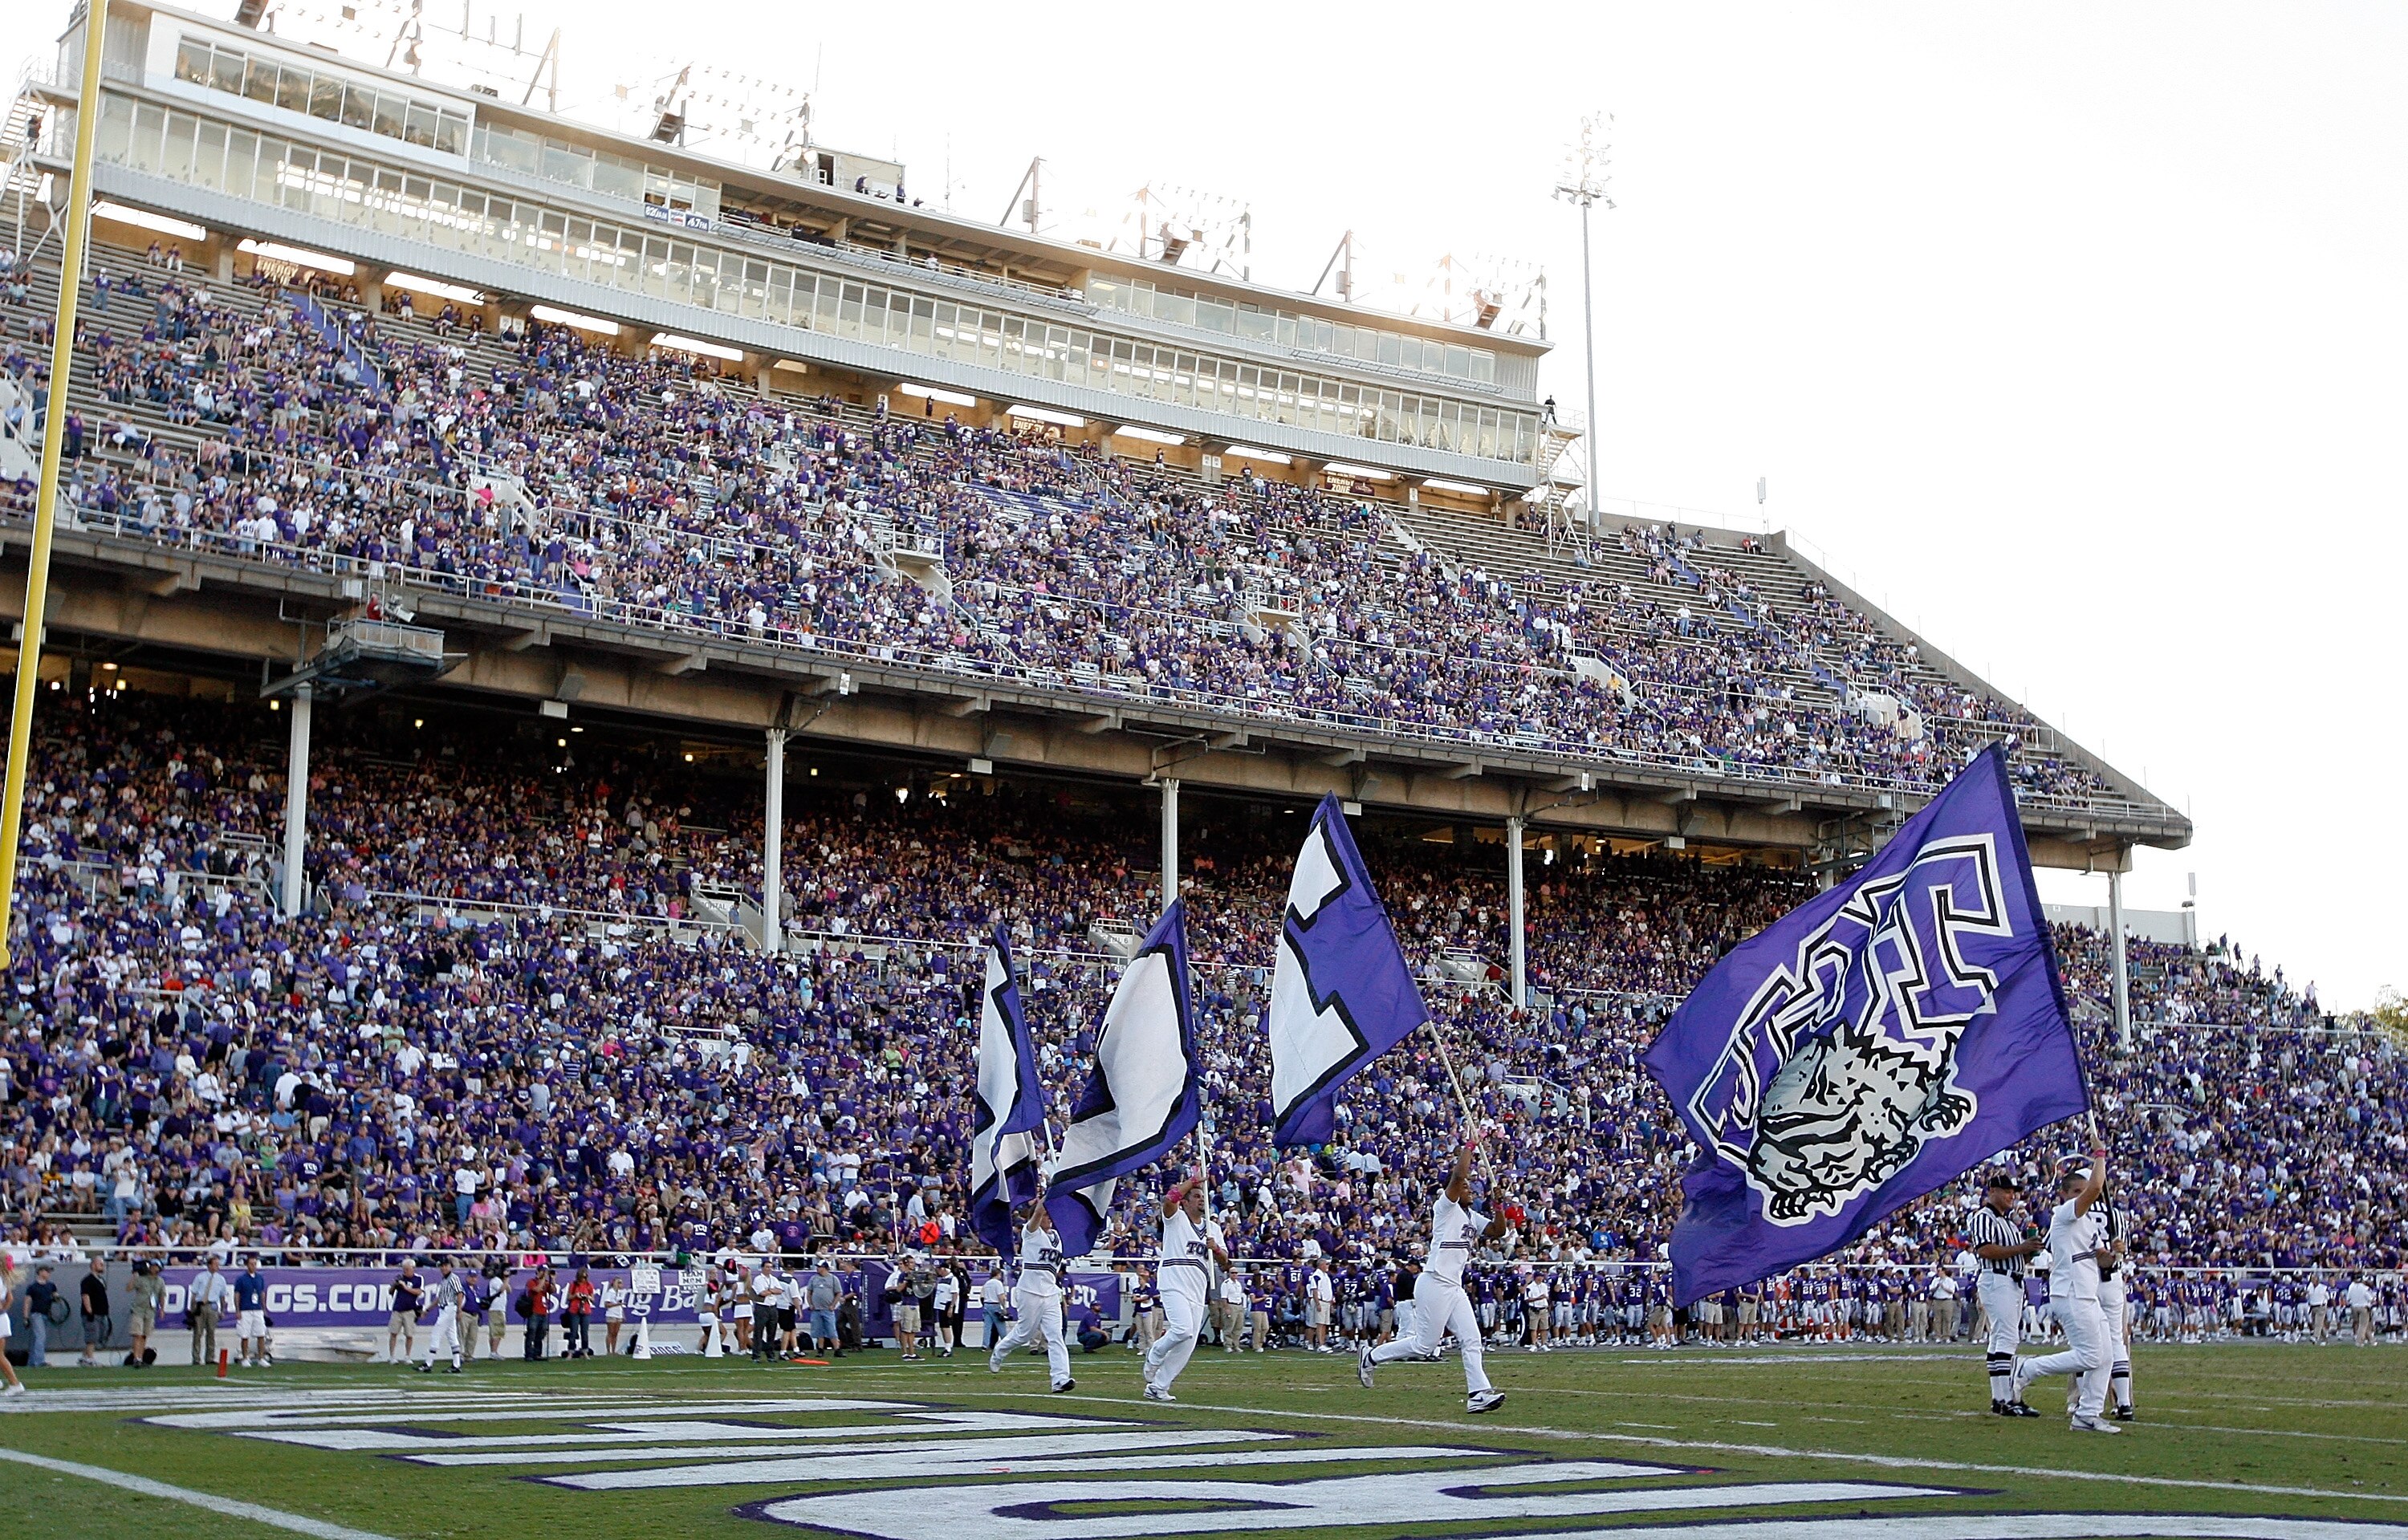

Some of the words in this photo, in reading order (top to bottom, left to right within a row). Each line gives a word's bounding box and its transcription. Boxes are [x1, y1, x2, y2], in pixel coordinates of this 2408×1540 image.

[1331, 484, 1351, 493] ZONE
[749, 1210, 761, 1221] 14
[694, 1225, 708, 1233] TCU
[1344, 1283, 1357, 1293] 57
[1629, 1287, 1642, 1298] 32
